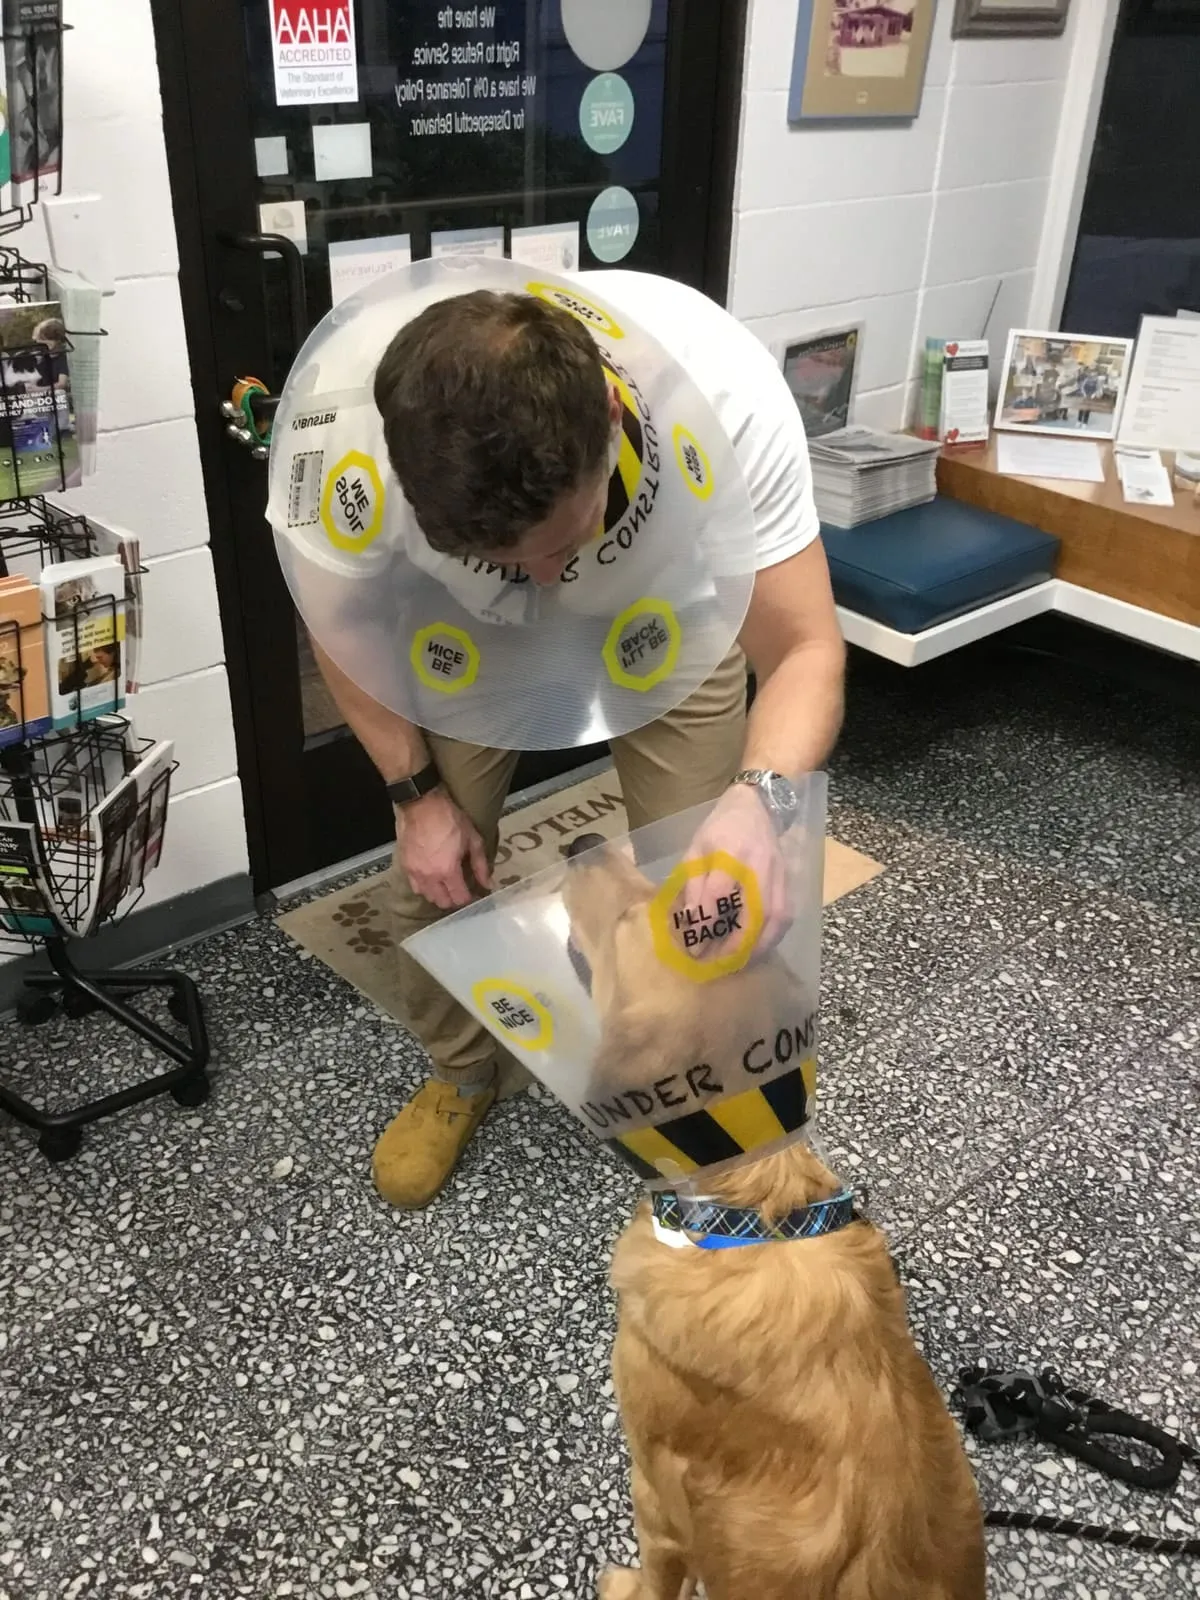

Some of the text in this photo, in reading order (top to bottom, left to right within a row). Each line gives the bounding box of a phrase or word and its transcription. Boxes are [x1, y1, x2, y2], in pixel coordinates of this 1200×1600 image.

[276, 7, 351, 44] AAHA
[279, 48, 352, 62] ACCREDITED
[287, 71, 343, 84] The Standard of
[279, 85, 354, 99] Veterinary Excellence
[23, 403, 67, 414] PROTECTON
[673, 890, 743, 929] I'LL BE
[683, 913, 742, 947] BACK
[491, 998, 515, 1015] BE
[498, 1009, 535, 1030] NICE
[580, 1063, 724, 1128] UNDER
